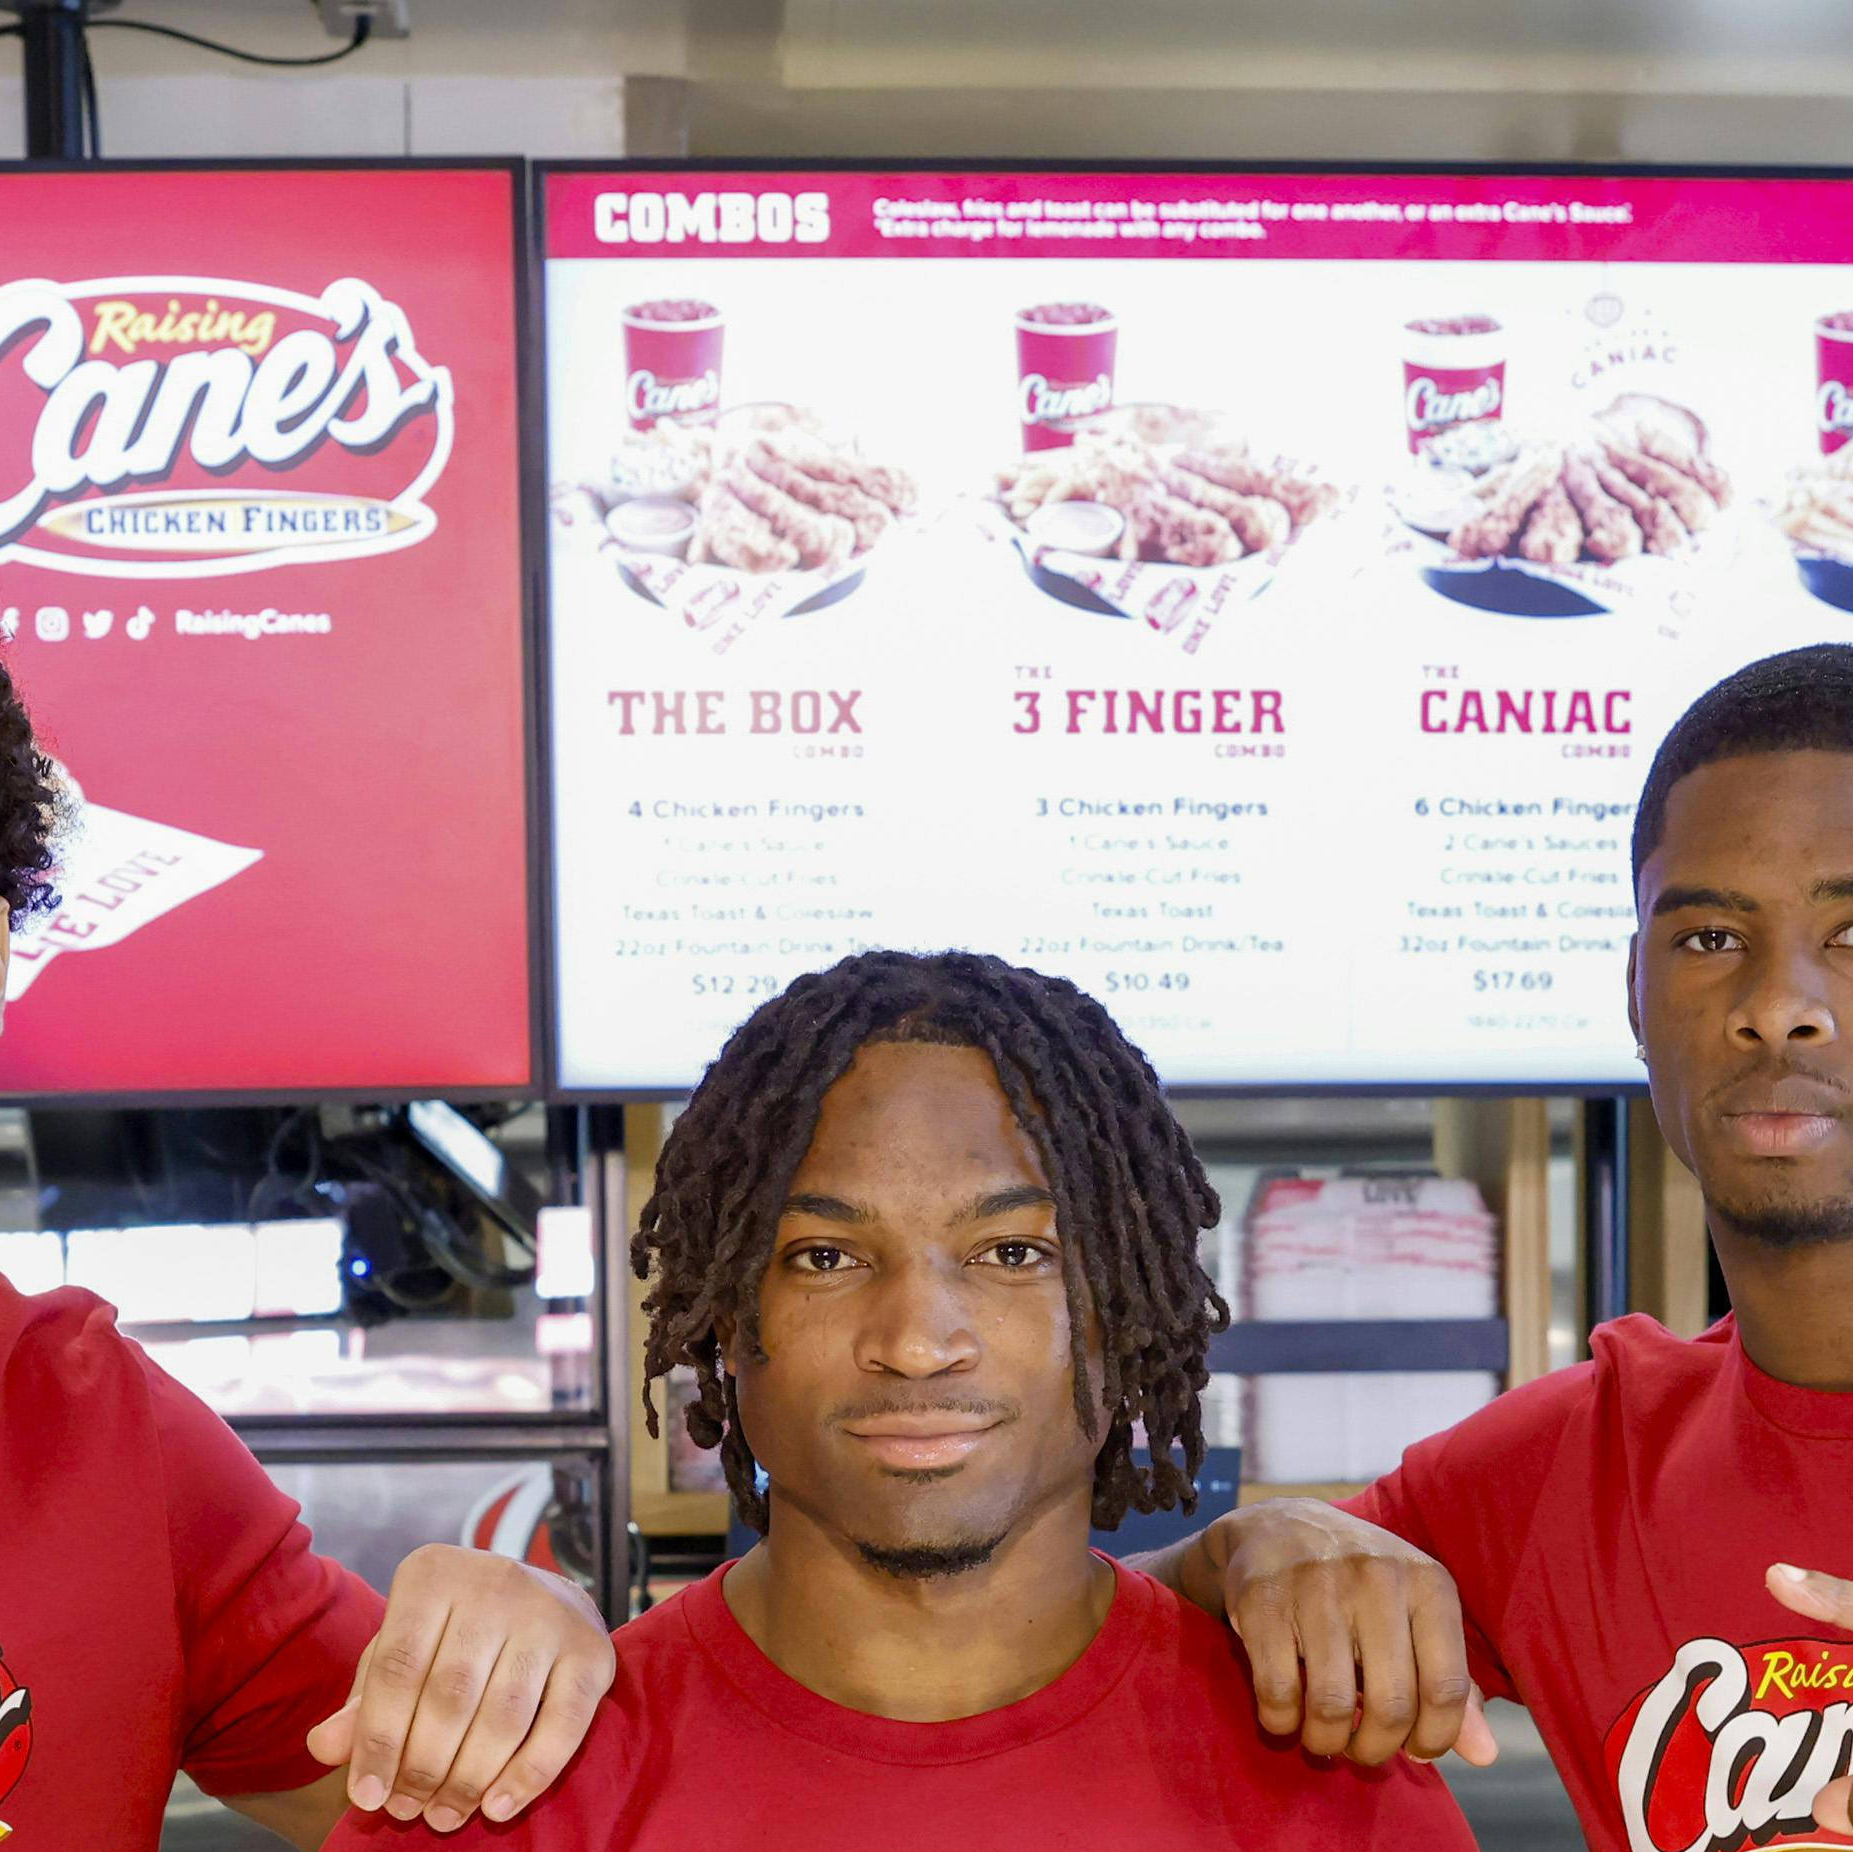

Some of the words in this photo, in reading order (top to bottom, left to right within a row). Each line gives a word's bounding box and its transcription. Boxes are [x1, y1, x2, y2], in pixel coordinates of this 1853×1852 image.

[594, 192, 830, 244] COMBOS
[1007, 200, 1042, 218] and
[1093, 201, 1128, 218] can
[1131, 200, 1155, 218] be
[1262, 201, 1289, 220] for
[1292, 203, 1328, 220] one
[1406, 204, 1425, 221] or
[1429, 204, 1453, 221] an
[1455, 202, 1501, 222] extra
[88, 300, 278, 356] Raising
[1571, 345, 1677, 389] CANIAC
[84, 504, 227, 537] CHICKEN
[240, 503, 384, 535] FINGERS
[174, 608, 333, 641] RaisingCanes
[1014, 664, 1054, 680] THE
[1422, 664, 1460, 680] THE
[608, 691, 727, 736] THE
[748, 690, 863, 735] BOX
[1013, 691, 1041, 735] 3
[1065, 690, 1286, 735] FINGER
[1420, 690, 1632, 735] CANIAC
[792, 744, 865, 760] COMBO
[1213, 743, 1287, 759] COMBO
[1561, 743, 1632, 759] COMBO
[627, 799, 643, 819] 4
[652, 799, 759, 819] Chicken
[767, 799, 865, 823] Fingers
[1035, 797, 1049, 817] 3
[1058, 797, 1163, 817] Chicken
[1173, 797, 1269, 821] Fingers
[1414, 797, 1430, 817] 6
[1439, 797, 1542, 817] Chicken
[1544, 834, 1618, 851] Sauces
[1567, 867, 1619, 885] Fries
[623, 904, 681, 922] Texas
[692, 904, 746, 922] Toast
[754, 904, 767, 922] &
[1092, 901, 1149, 919] Texas
[1159, 901, 1215, 919] Toast
[1407, 901, 1463, 919] Texas
[1474, 901, 1528, 919] Toast
[1535, 901, 1548, 919] &
[614, 939, 666, 957] 22oz
[675, 939, 771, 957] Fountain
[1020, 936, 1070, 953] 22oz
[1079, 936, 1174, 953] Fountain
[1400, 935, 1449, 953] 32oz
[1457, 935, 1550, 953] Fountain
[1104, 972, 1191, 994] $10.49
[1473, 970, 1554, 993] $17.69
